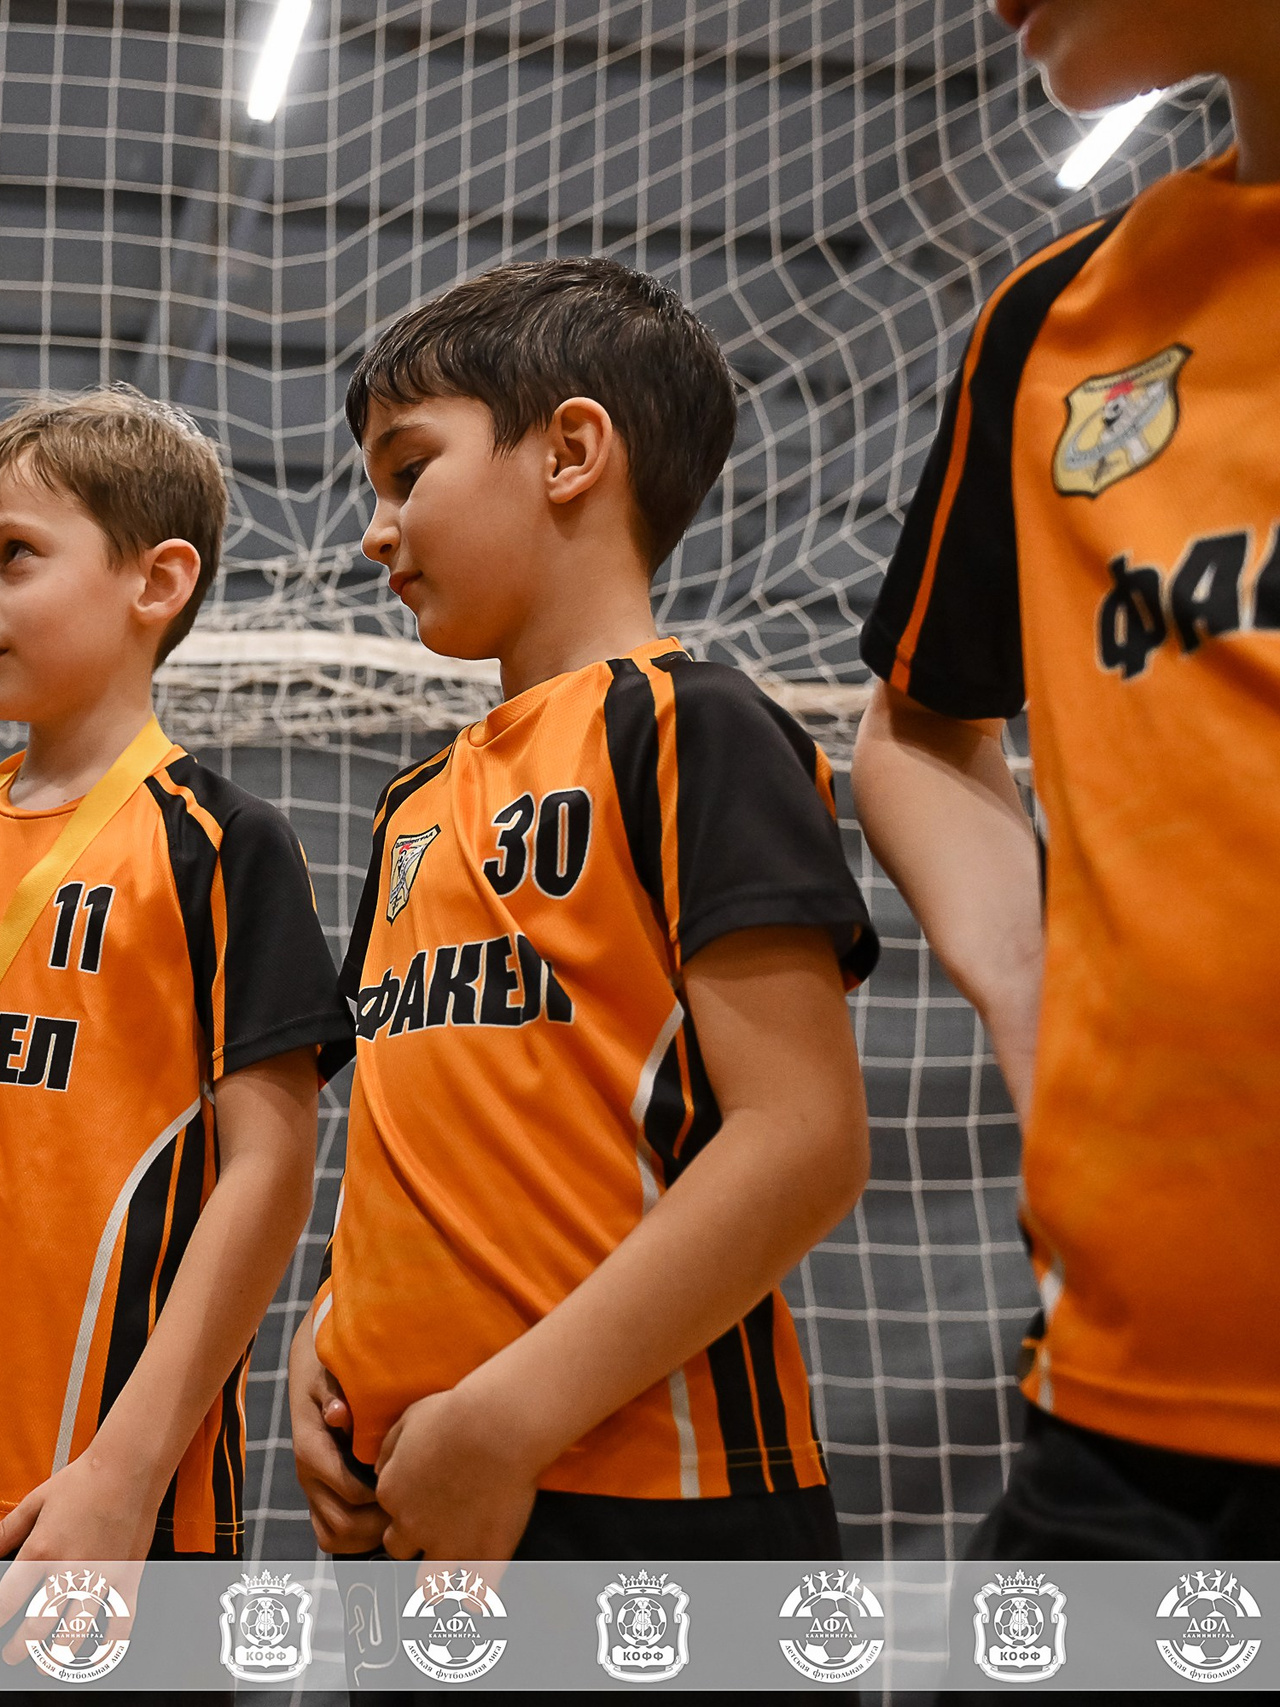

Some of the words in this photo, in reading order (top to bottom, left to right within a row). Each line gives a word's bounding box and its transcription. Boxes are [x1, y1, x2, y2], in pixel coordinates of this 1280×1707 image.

[1096, 522, 1280, 684] ФА
[482, 786, 593, 900] 30
[48, 881, 116, 974] 11
[356, 932, 575, 1043] ФАКЕЛ
